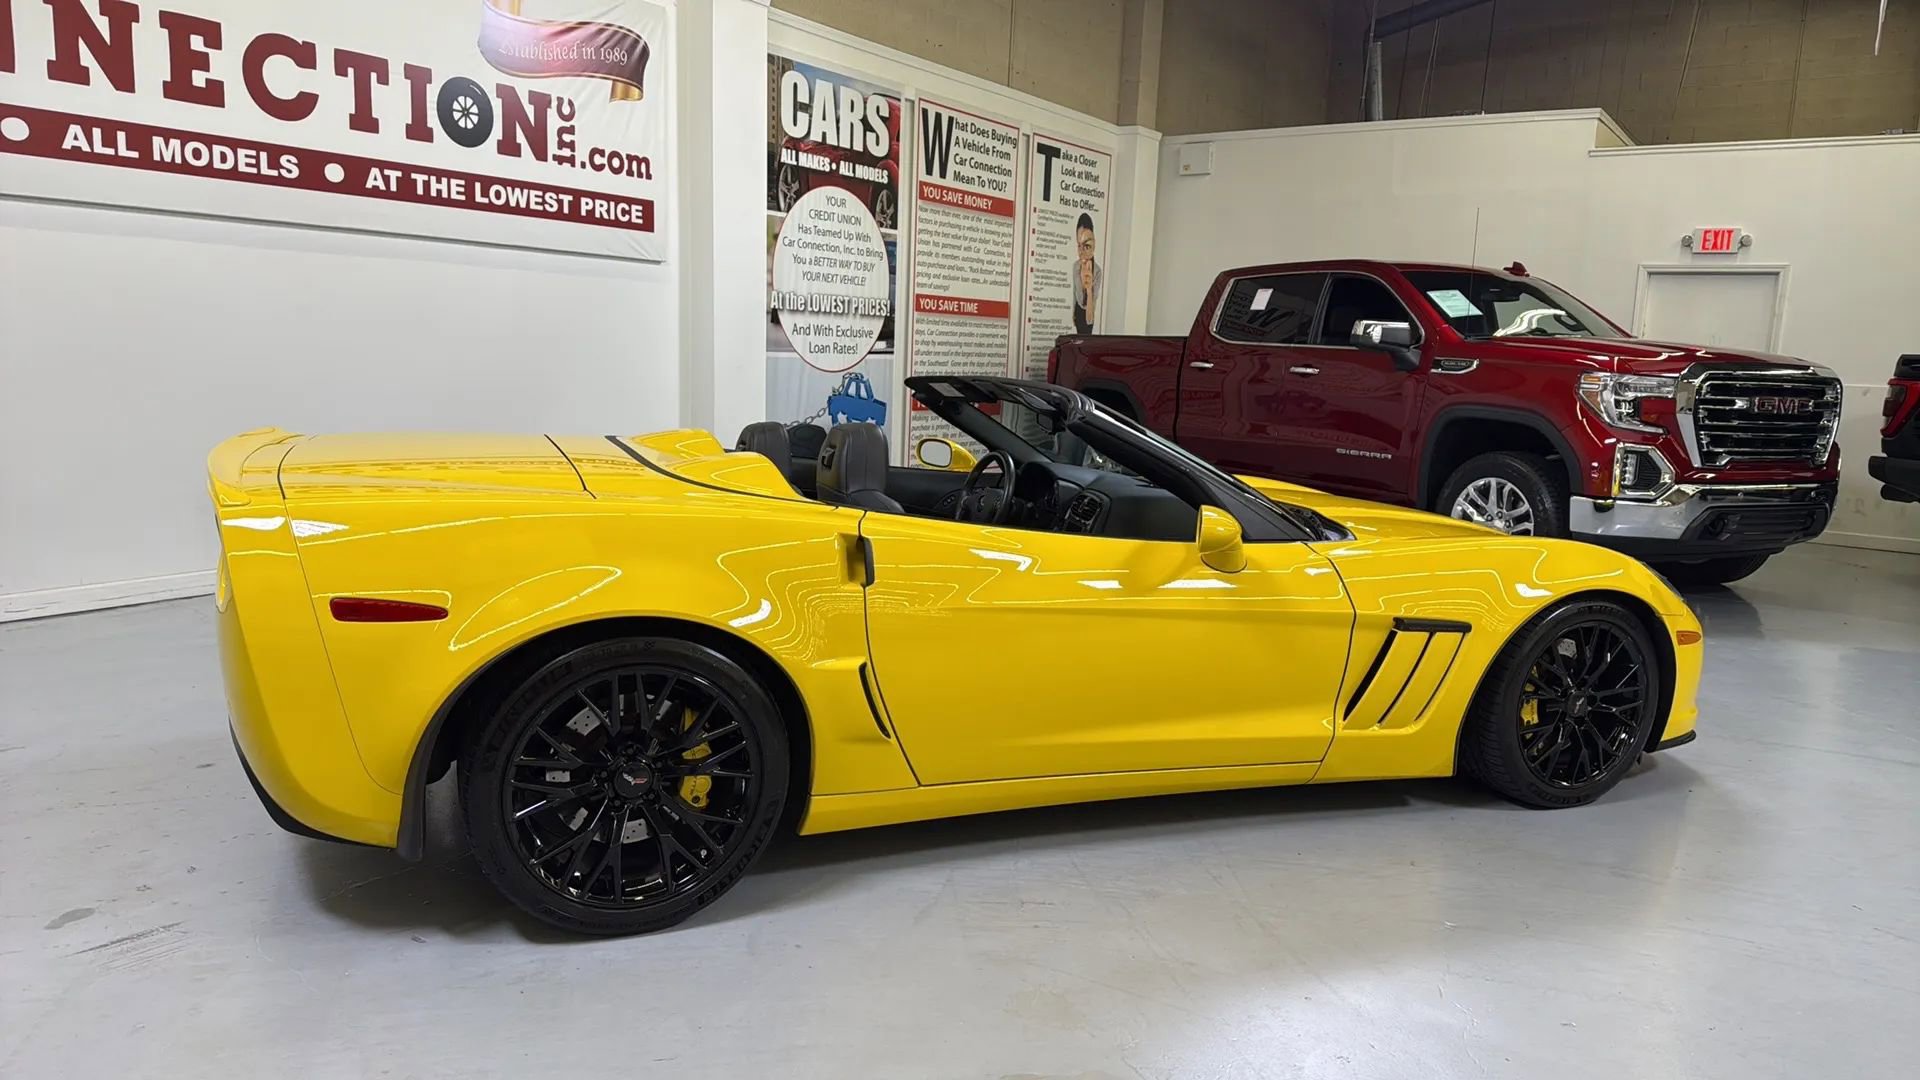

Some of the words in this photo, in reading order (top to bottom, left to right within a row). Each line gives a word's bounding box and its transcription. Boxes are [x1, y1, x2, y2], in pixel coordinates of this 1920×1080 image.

[498, 39, 581, 61] Established
[583, 45, 596, 60] in
[600, 47, 628, 65] 1989
[0, 0, 552, 163] NECTION
[781, 71, 889, 157] CARS
[970, 123, 989, 139] Does
[992, 128, 1017, 149] Buying
[61, 124, 139, 158] ALL
[152, 135, 300, 180] MODELS
[954, 136, 960, 148] A
[961, 138, 990, 156] Vehicle
[992, 146, 1011, 160] From
[580, 147, 652, 180] .com
[781, 148, 797, 165] ALL
[799, 152, 830, 171] MAKES
[954, 153, 967, 166] Car
[969, 157, 1012, 177] Connection
[1079, 154, 1097, 168] Closer
[839, 160, 854, 176] ALL
[855, 163, 888, 184] MODELS
[953, 170, 975, 185] Mean
[977, 176, 985, 188] To
[987, 178, 1007, 192] YOU?
[1061, 165, 1076, 177] Look
[1077, 171, 1083, 180] at
[1085, 170, 1099, 183] What
[365, 165, 402, 192] AT
[411, 172, 466, 201] THE
[474, 182, 573, 214] LOWEST
[579, 197, 644, 225] PRICE
[922, 185, 940, 199] YOU
[942, 190, 962, 204] SAVE
[964, 195, 992, 210] MONEY
[1060, 180, 1071, 191] Car
[1072, 182, 1104, 199] Connection
[825, 195, 846, 208] YOUR
[1060, 194, 1071, 206] Has
[1072, 198, 1078, 208] to
[808, 209, 836, 222] CREDIT
[838, 213, 861, 225] UNION
[798, 224, 812, 234] Has
[814, 225, 842, 238] Teamed
[844, 229, 854, 241] Up
[855, 231, 871, 242] With
[1701, 229, 1734, 250] EXIT
[783, 237, 795, 247] Car
[798, 239, 841, 253] Connection,
[857, 248, 864, 256] to
[866, 250, 883, 261] Bring
[792, 254, 807, 265] You
[809, 257, 812, 265] a
[814, 256, 837, 268] BETTER
[839, 258, 851, 270] WAY
[854, 261, 862, 271] TO
[863, 262, 875, 272] BUY
[802, 271, 820, 281] YOUR
[822, 272, 838, 284] NEXT
[840, 274, 866, 286] VEHICLE!
[770, 290, 783, 309] At
[786, 292, 805, 311] the
[807, 294, 850, 314] LOWEST
[852, 298, 890, 316] PRICES!
[920, 298, 937, 310] YOU
[938, 299, 959, 311] SAVE
[960, 302, 978, 313] TIME
[792, 323, 811, 336] And
[813, 324, 833, 337] With
[836, 325, 873, 339] Exclusive
[809, 342, 830, 354] Loan
[833, 342, 858, 354] Rates!
